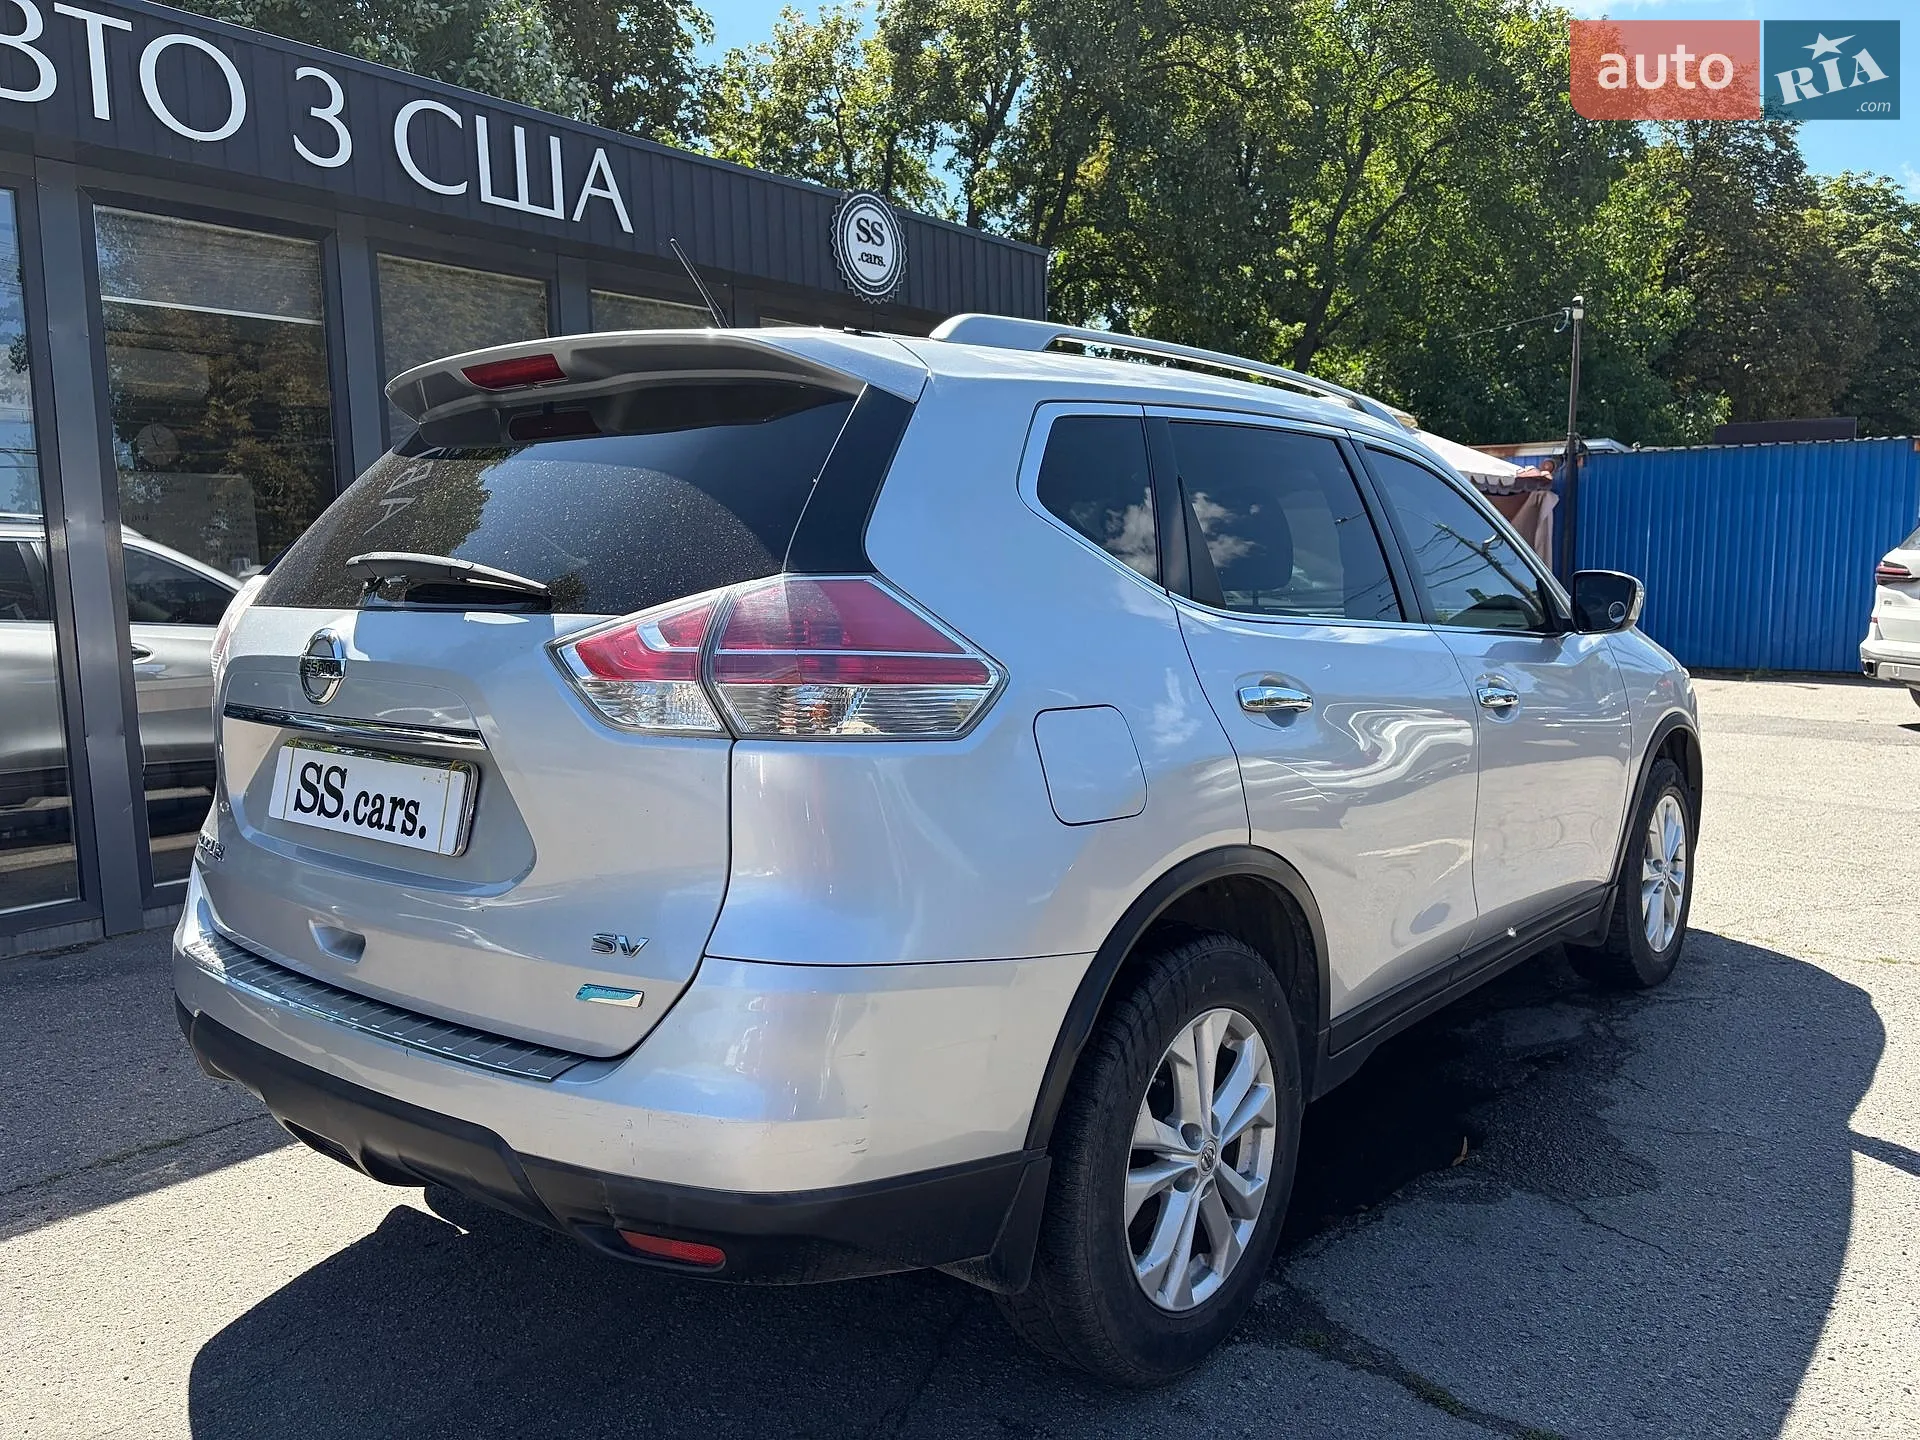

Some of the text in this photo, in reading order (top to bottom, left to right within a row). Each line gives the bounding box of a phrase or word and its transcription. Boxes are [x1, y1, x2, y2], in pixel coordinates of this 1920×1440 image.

[394, 100, 635, 234] США
[856, 217, 885, 247] SS
[293, 762, 427, 839] SS.cars.
[591, 933, 649, 958] SV
